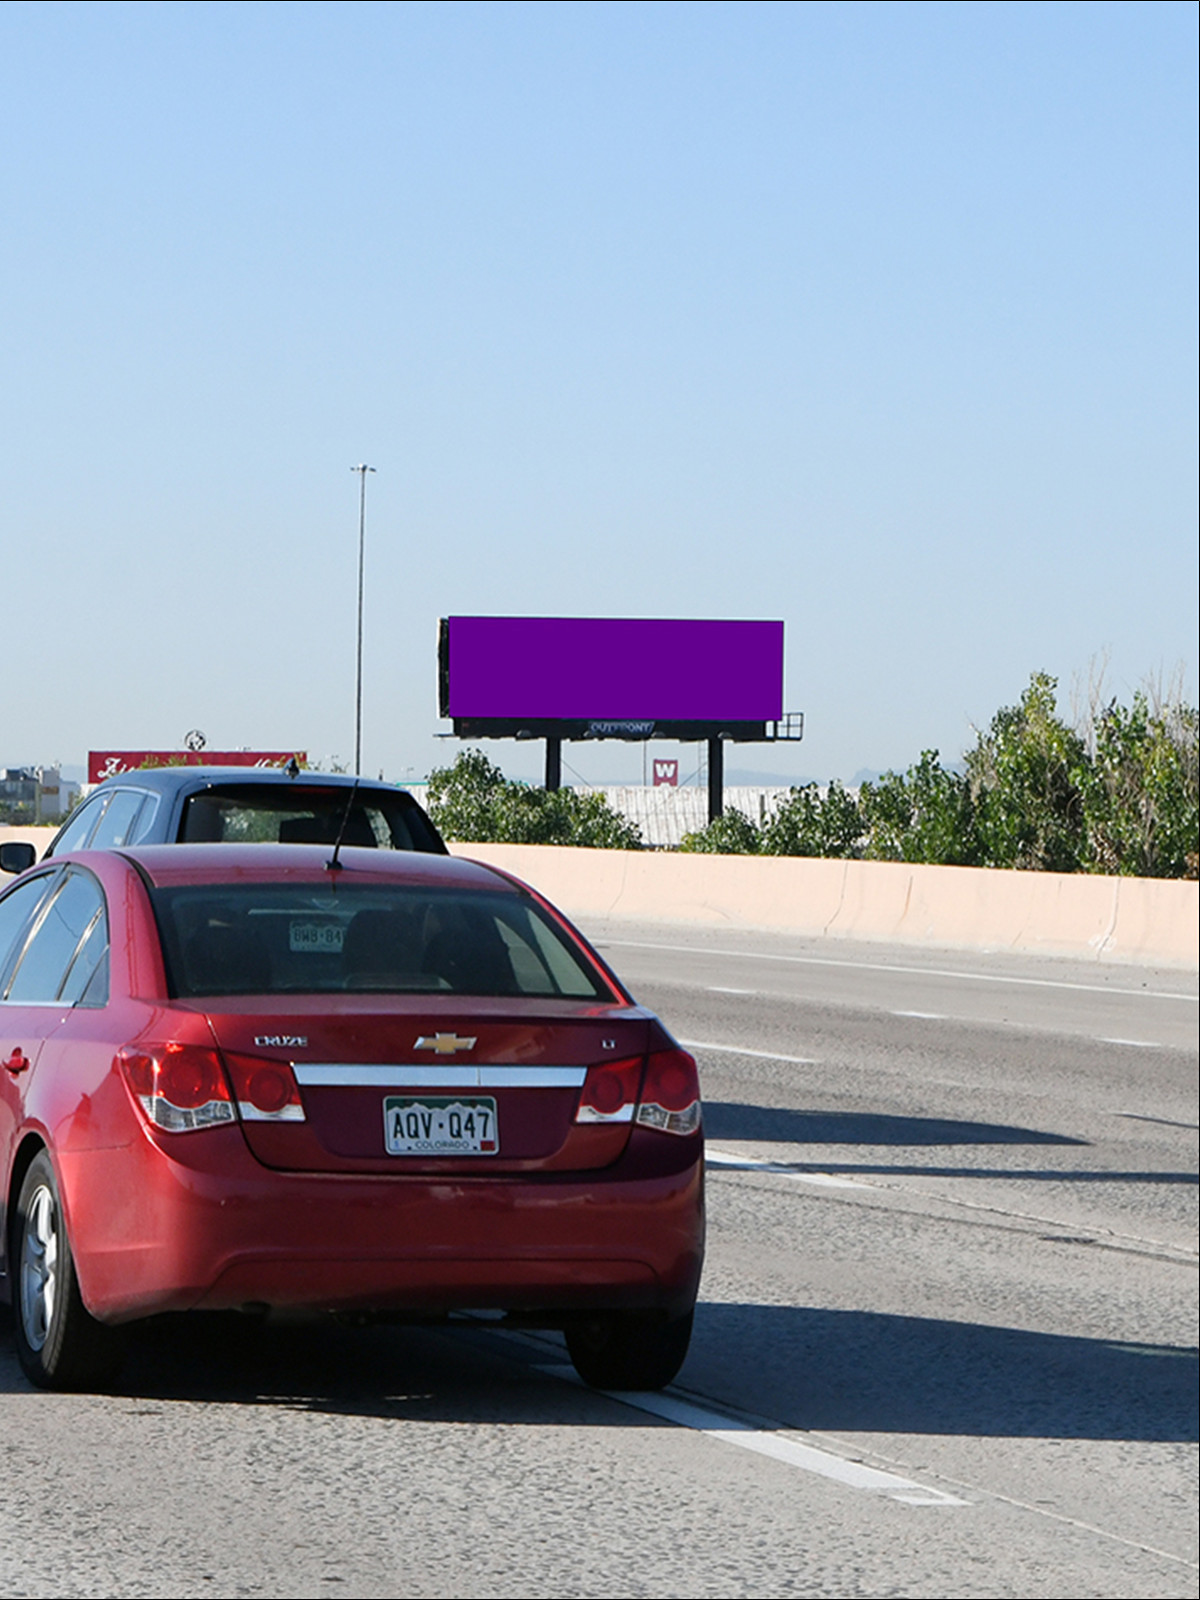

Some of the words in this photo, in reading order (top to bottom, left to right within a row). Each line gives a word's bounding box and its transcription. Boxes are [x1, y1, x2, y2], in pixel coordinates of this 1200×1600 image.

[655, 763, 675, 778] W
[254, 1036, 308, 1047] CRUZE
[602, 1040, 616, 1049] LT
[415, 1141, 470, 1149] COLORADO
